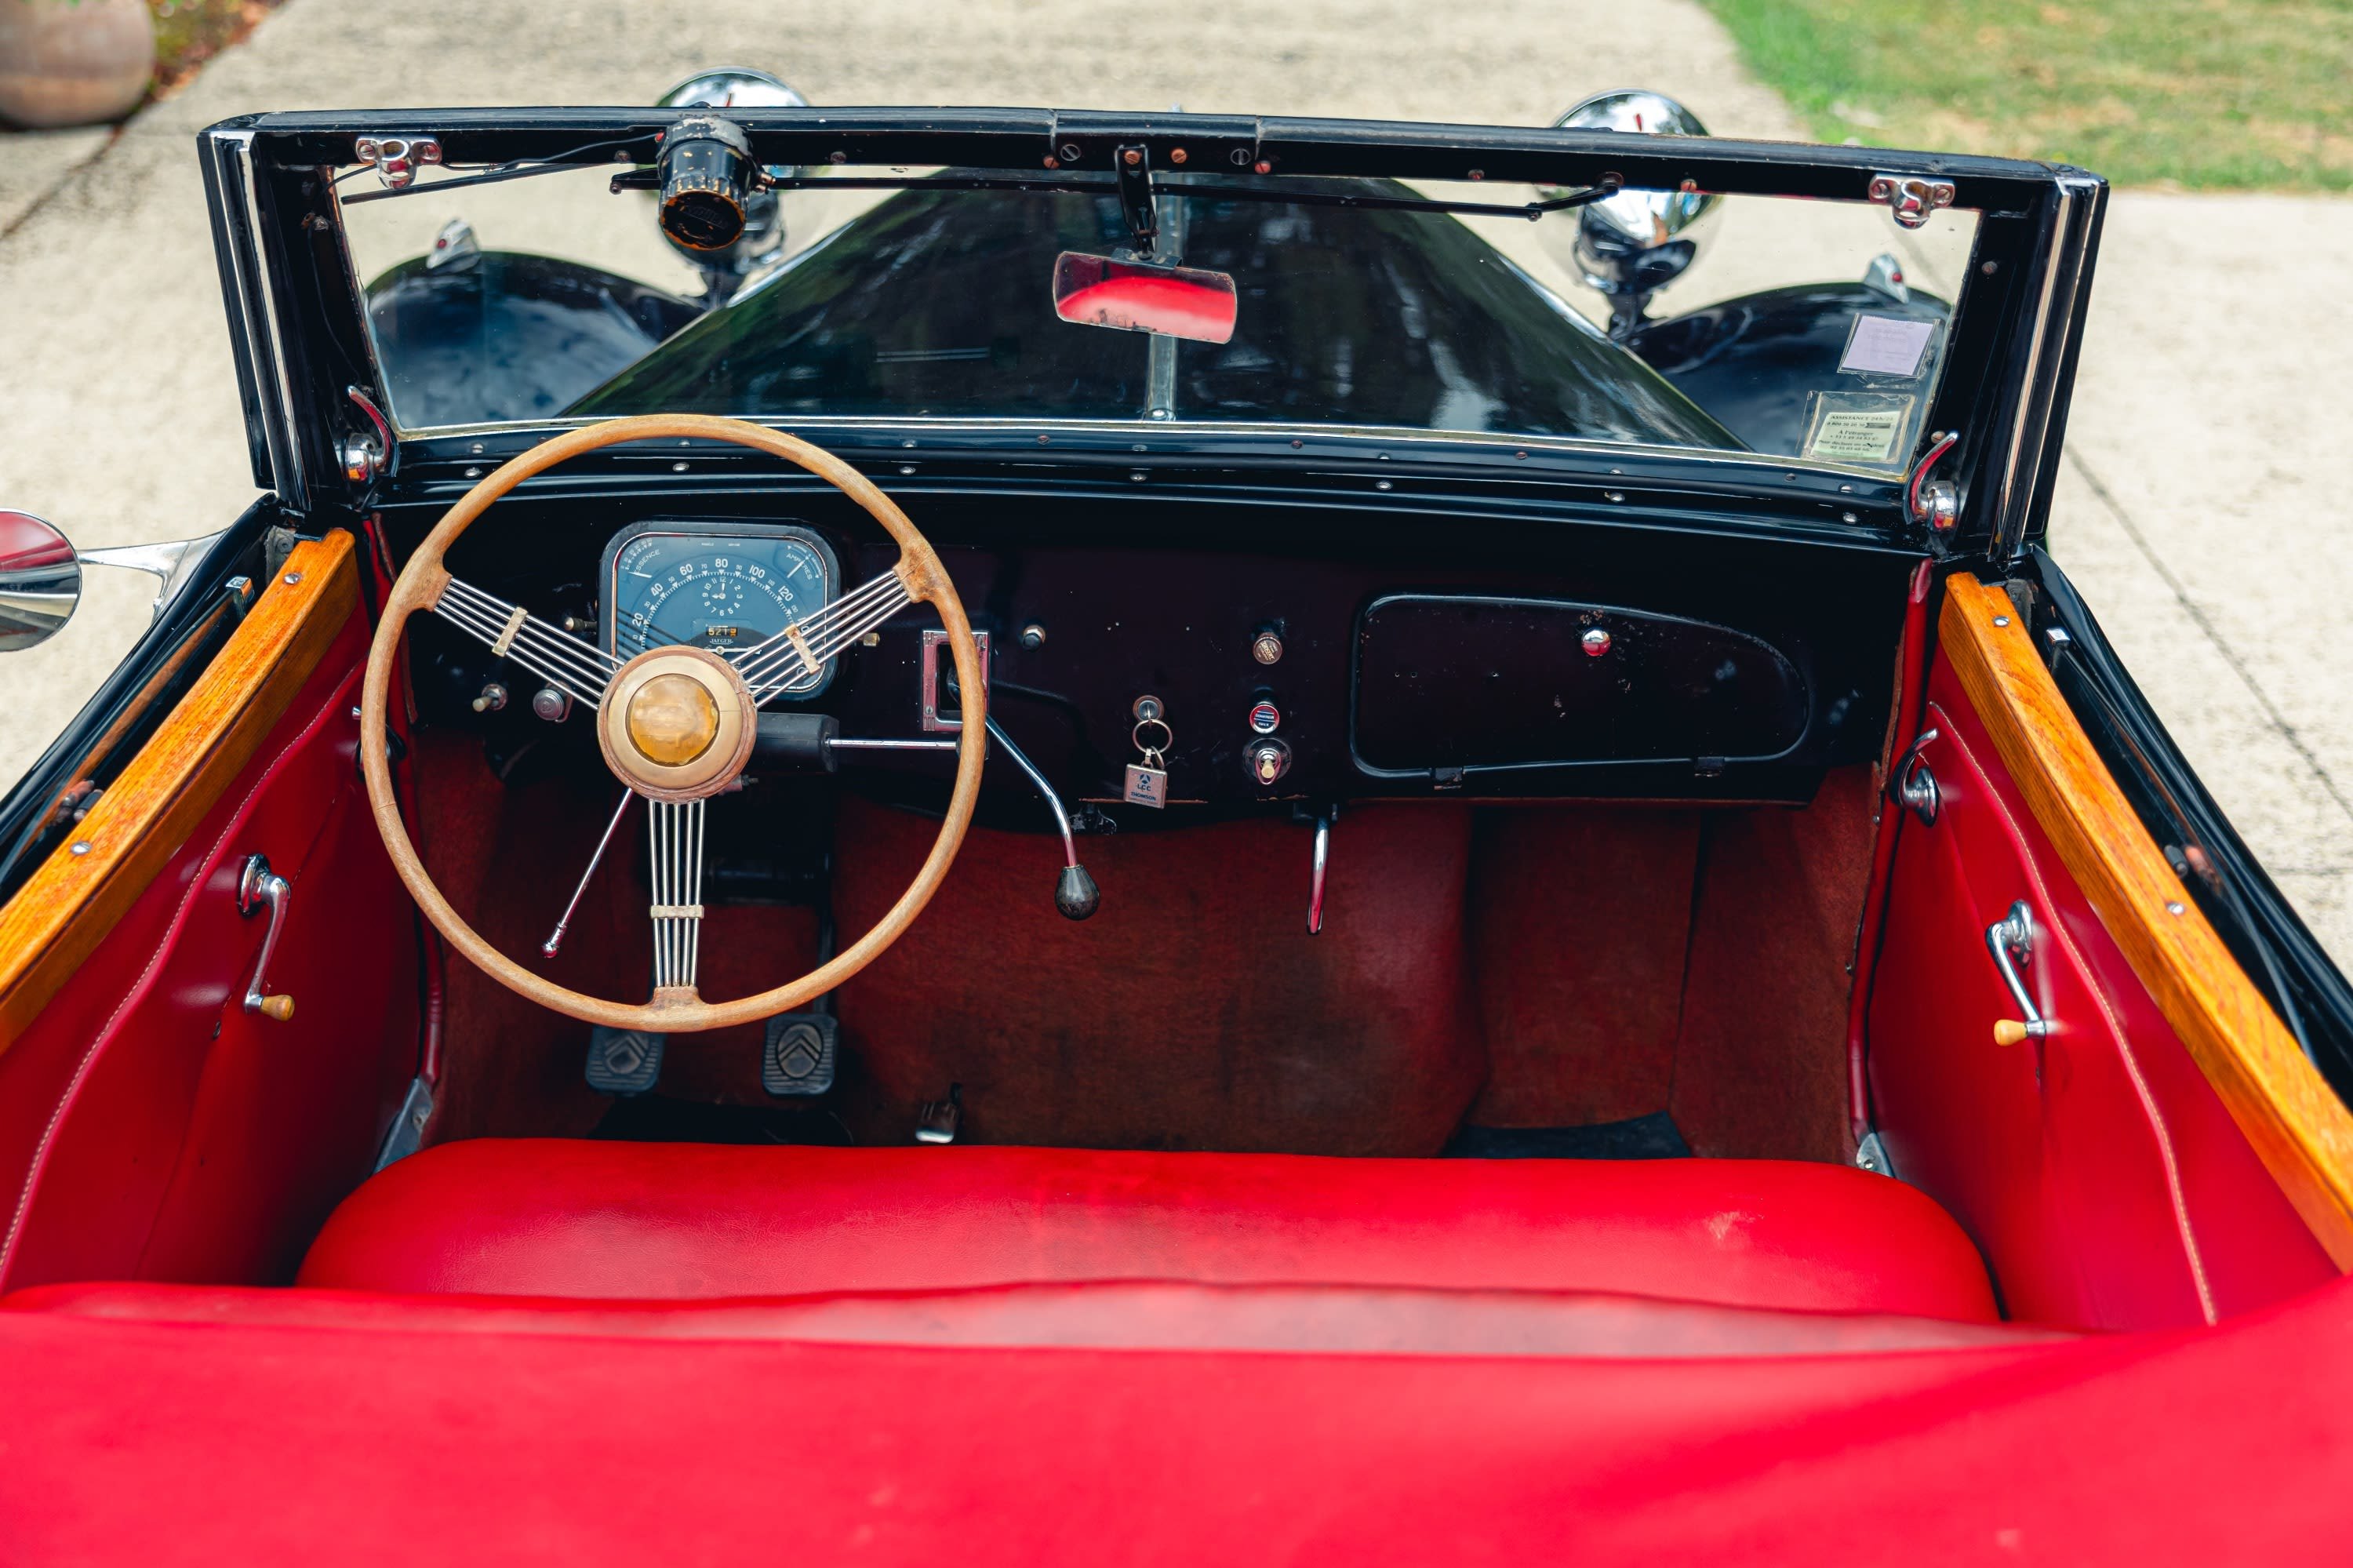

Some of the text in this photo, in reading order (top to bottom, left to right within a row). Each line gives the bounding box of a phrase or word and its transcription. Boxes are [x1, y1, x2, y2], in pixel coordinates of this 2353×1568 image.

[634, 549, 660, 573] ESSENCE
[715, 558, 729, 568] 80
[679, 563, 693, 576] 60
[749, 564, 766, 579] 100
[650, 583, 664, 596] 40
[777, 585, 794, 602] 120
[631, 612, 644, 627] 20
[1131, 791, 1156, 801] THOMSON
